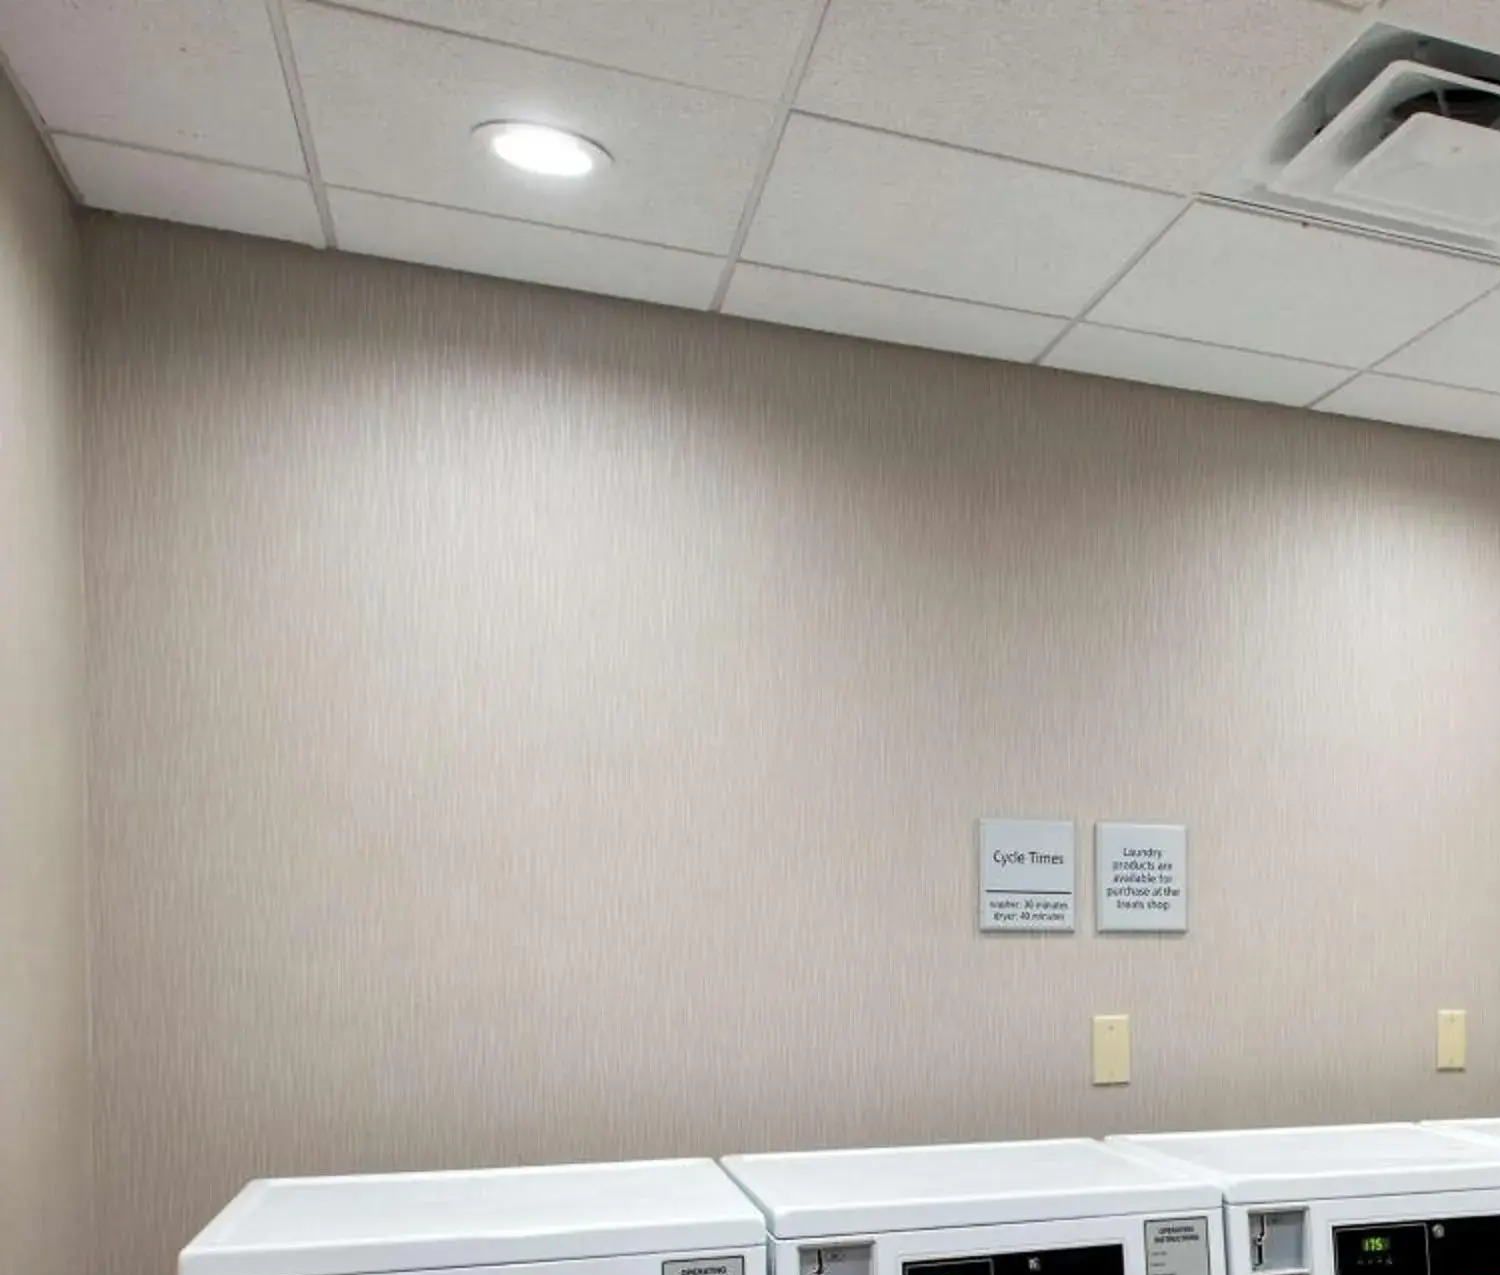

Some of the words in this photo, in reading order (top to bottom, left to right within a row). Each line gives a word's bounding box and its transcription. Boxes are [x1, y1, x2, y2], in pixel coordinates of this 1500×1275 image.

[993, 849, 1025, 868] Cycle
[1028, 851, 1064, 865] Times
[1122, 848, 1162, 860] Laundry
[1112, 860, 1155, 872] products
[1157, 863, 1172, 871] are
[1113, 873, 1157, 883] available
[1106, 886, 1150, 898] purchase
[1147, 899, 1170, 911] shop
